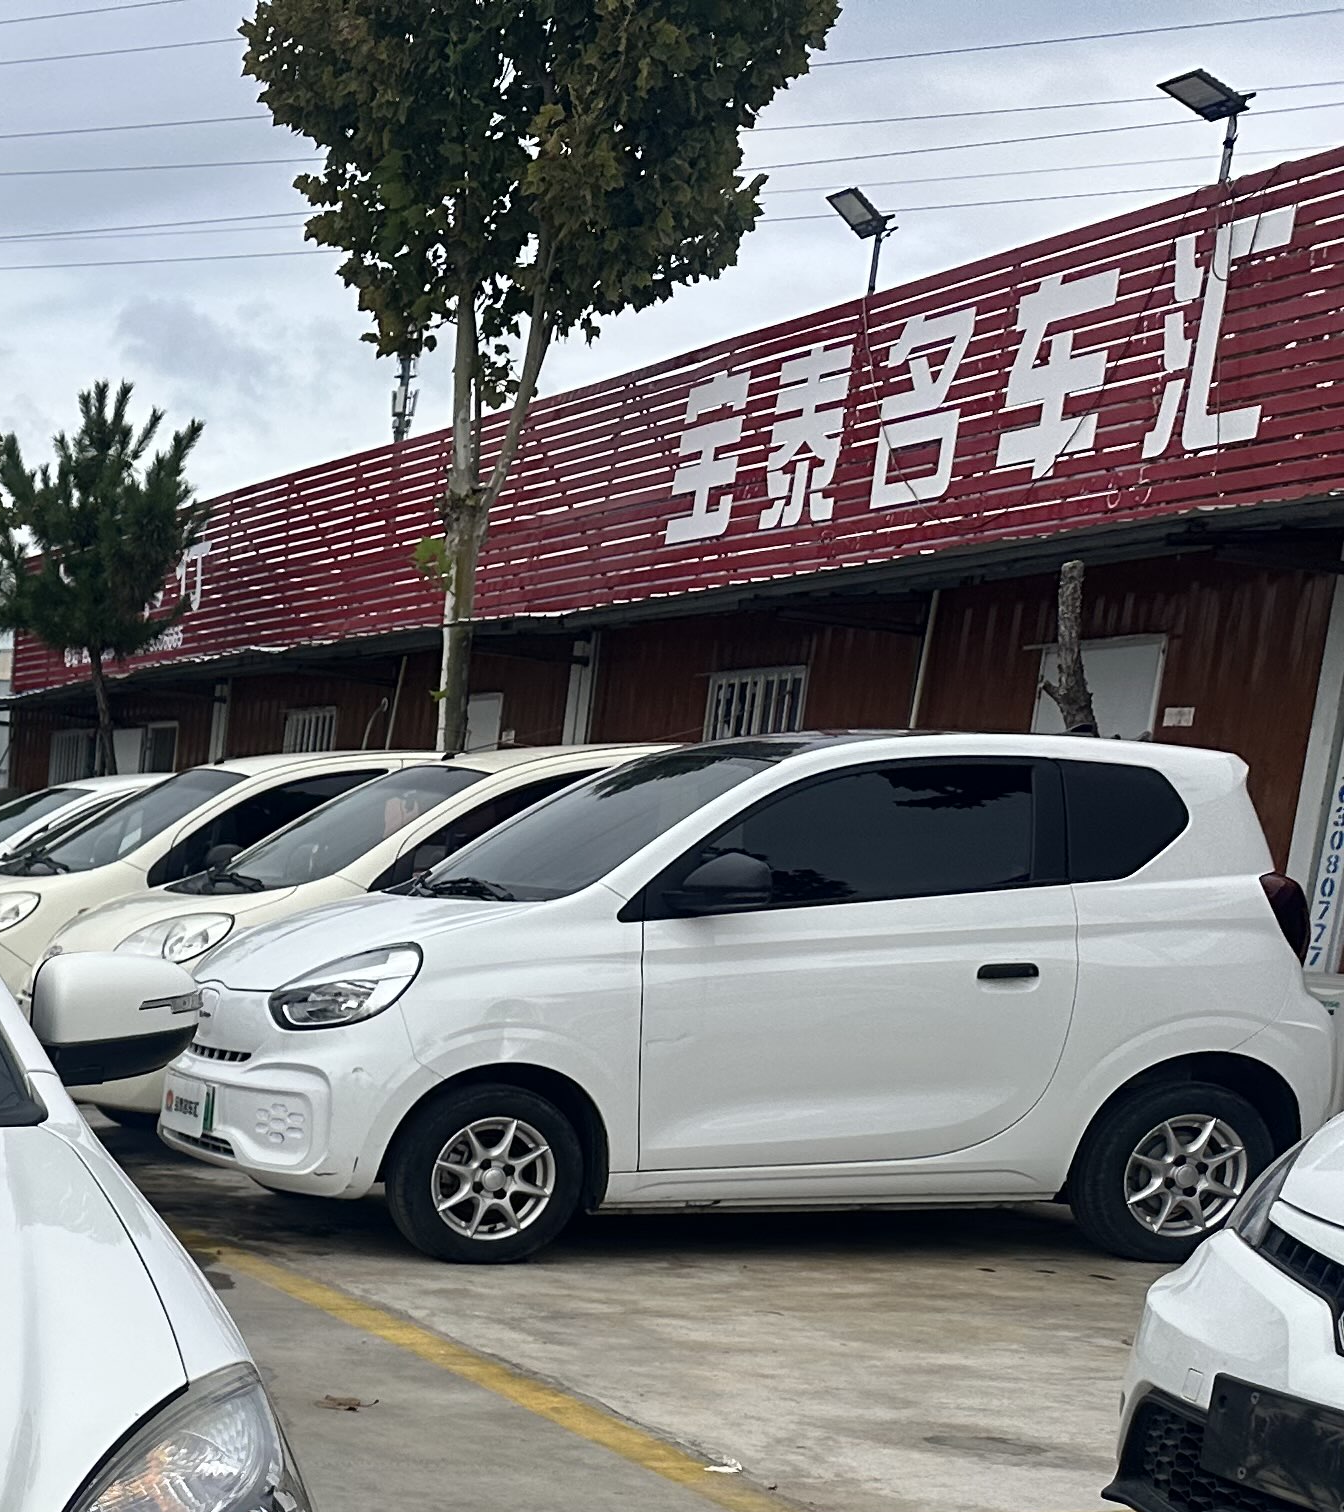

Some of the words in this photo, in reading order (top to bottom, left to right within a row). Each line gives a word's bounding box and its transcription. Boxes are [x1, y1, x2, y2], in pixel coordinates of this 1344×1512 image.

[665, 205, 1296, 545] 宝泰名车汇
